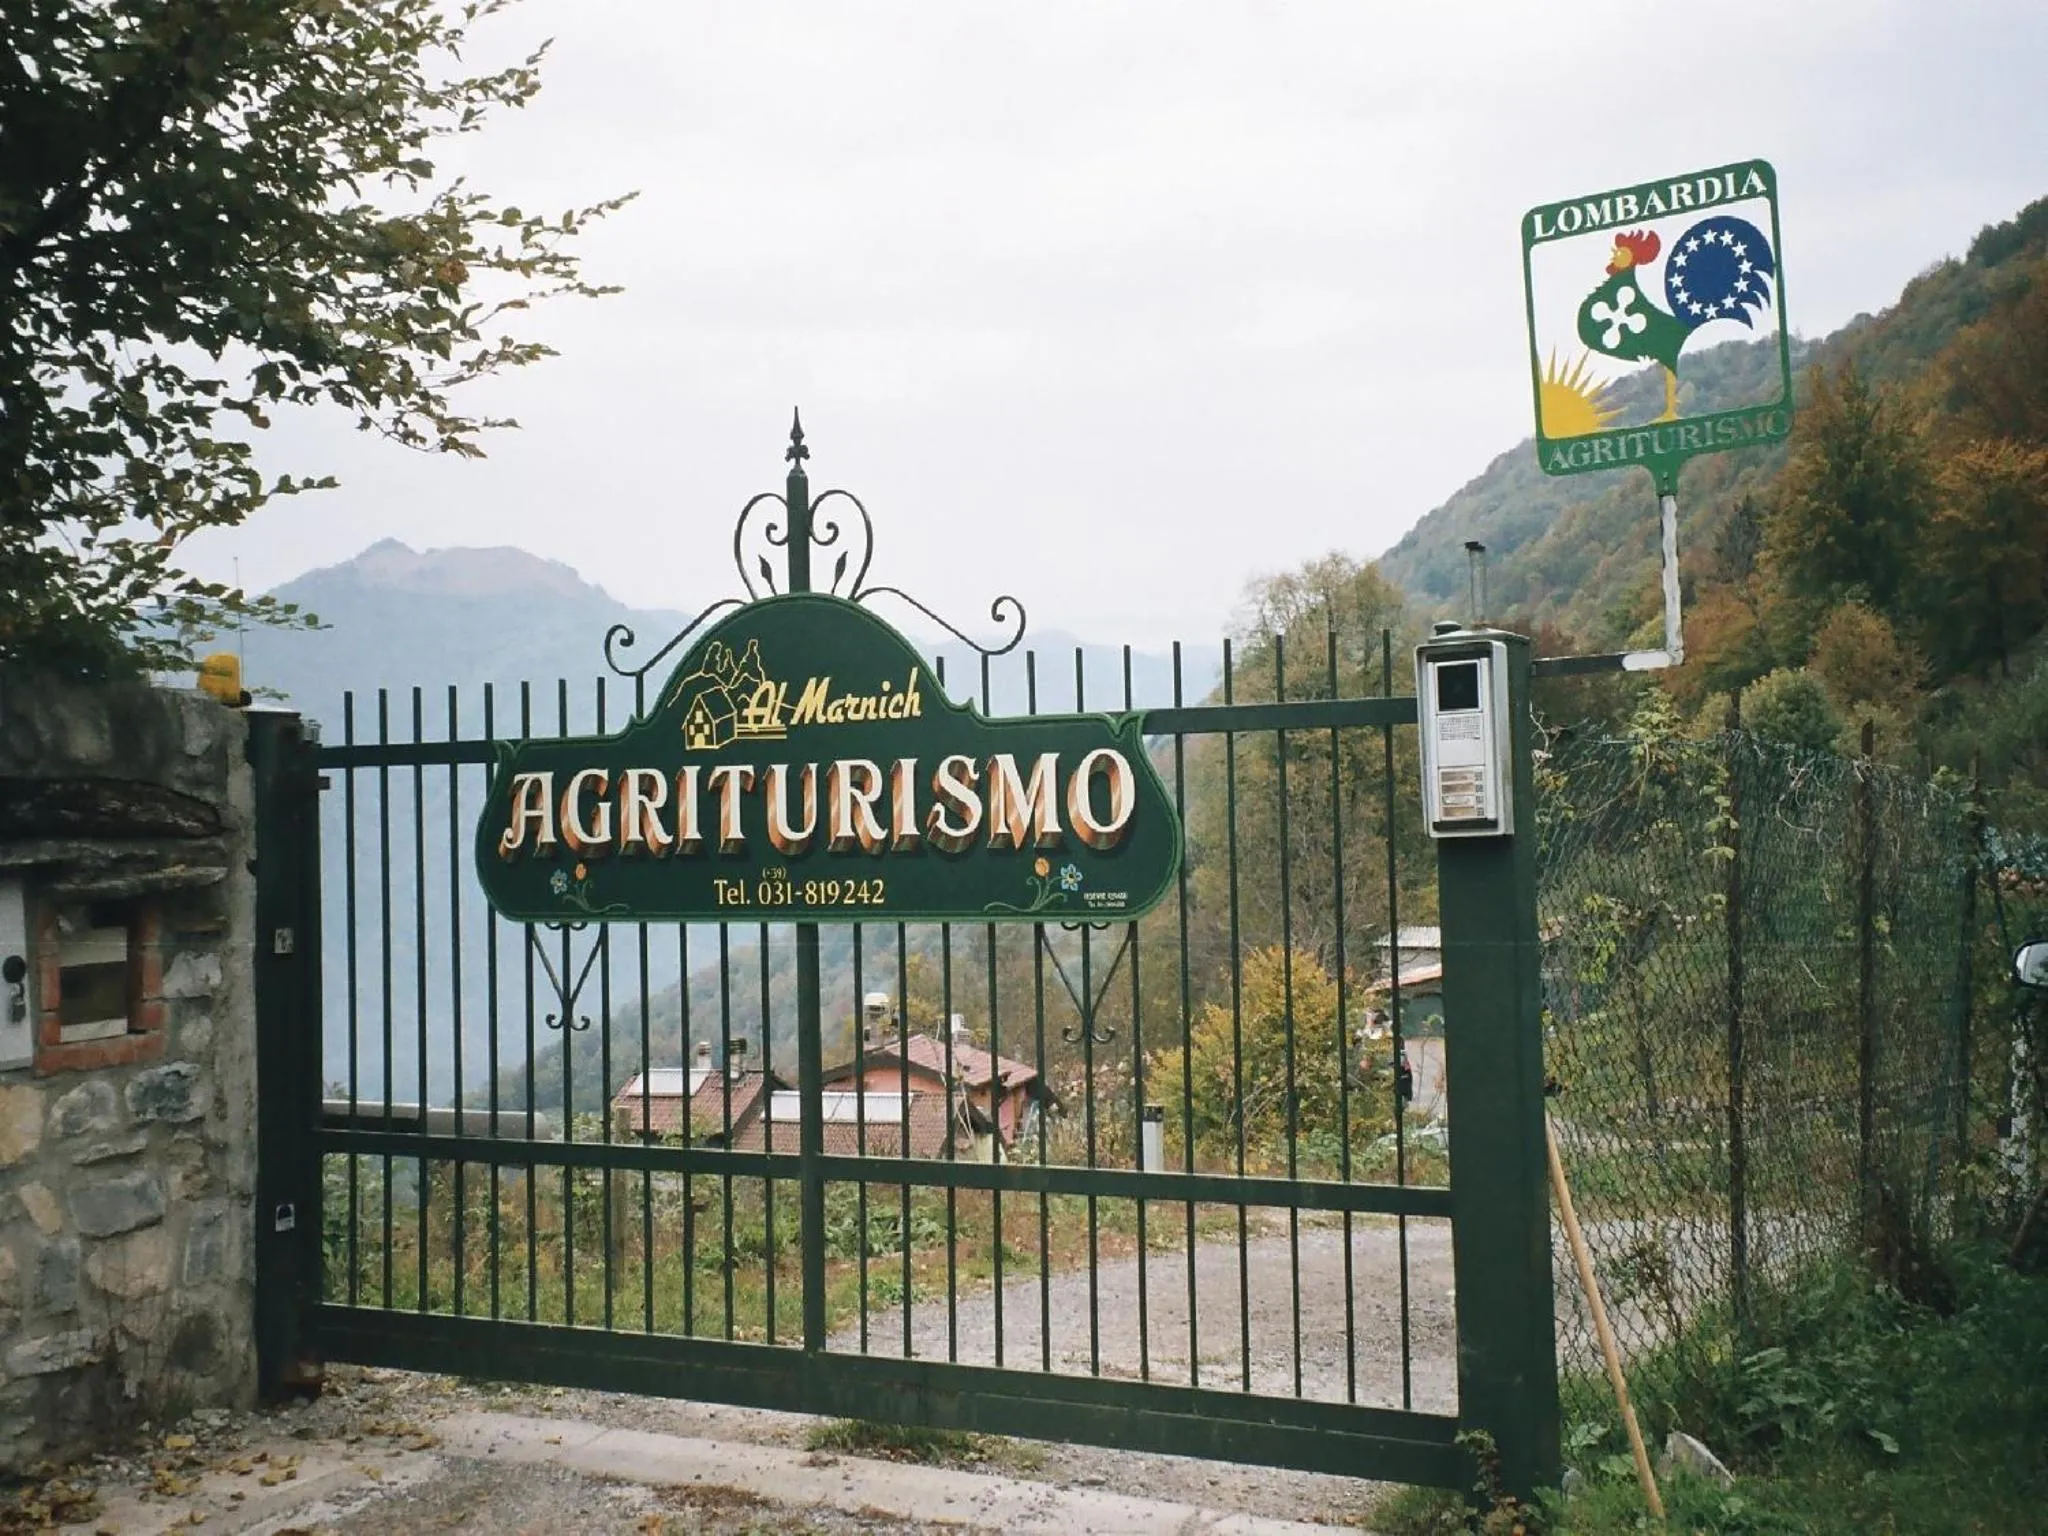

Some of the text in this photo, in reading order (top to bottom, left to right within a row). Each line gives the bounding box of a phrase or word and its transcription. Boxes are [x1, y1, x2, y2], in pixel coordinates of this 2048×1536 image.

[1532, 167, 1768, 239] LOMBARDIA
[1548, 408, 1790, 471] AGRITURISMO
[742, 667, 922, 731] Al Marnich
[500, 748, 1136, 856] AGRITURISMO
[713, 879, 751, 905] Tel.
